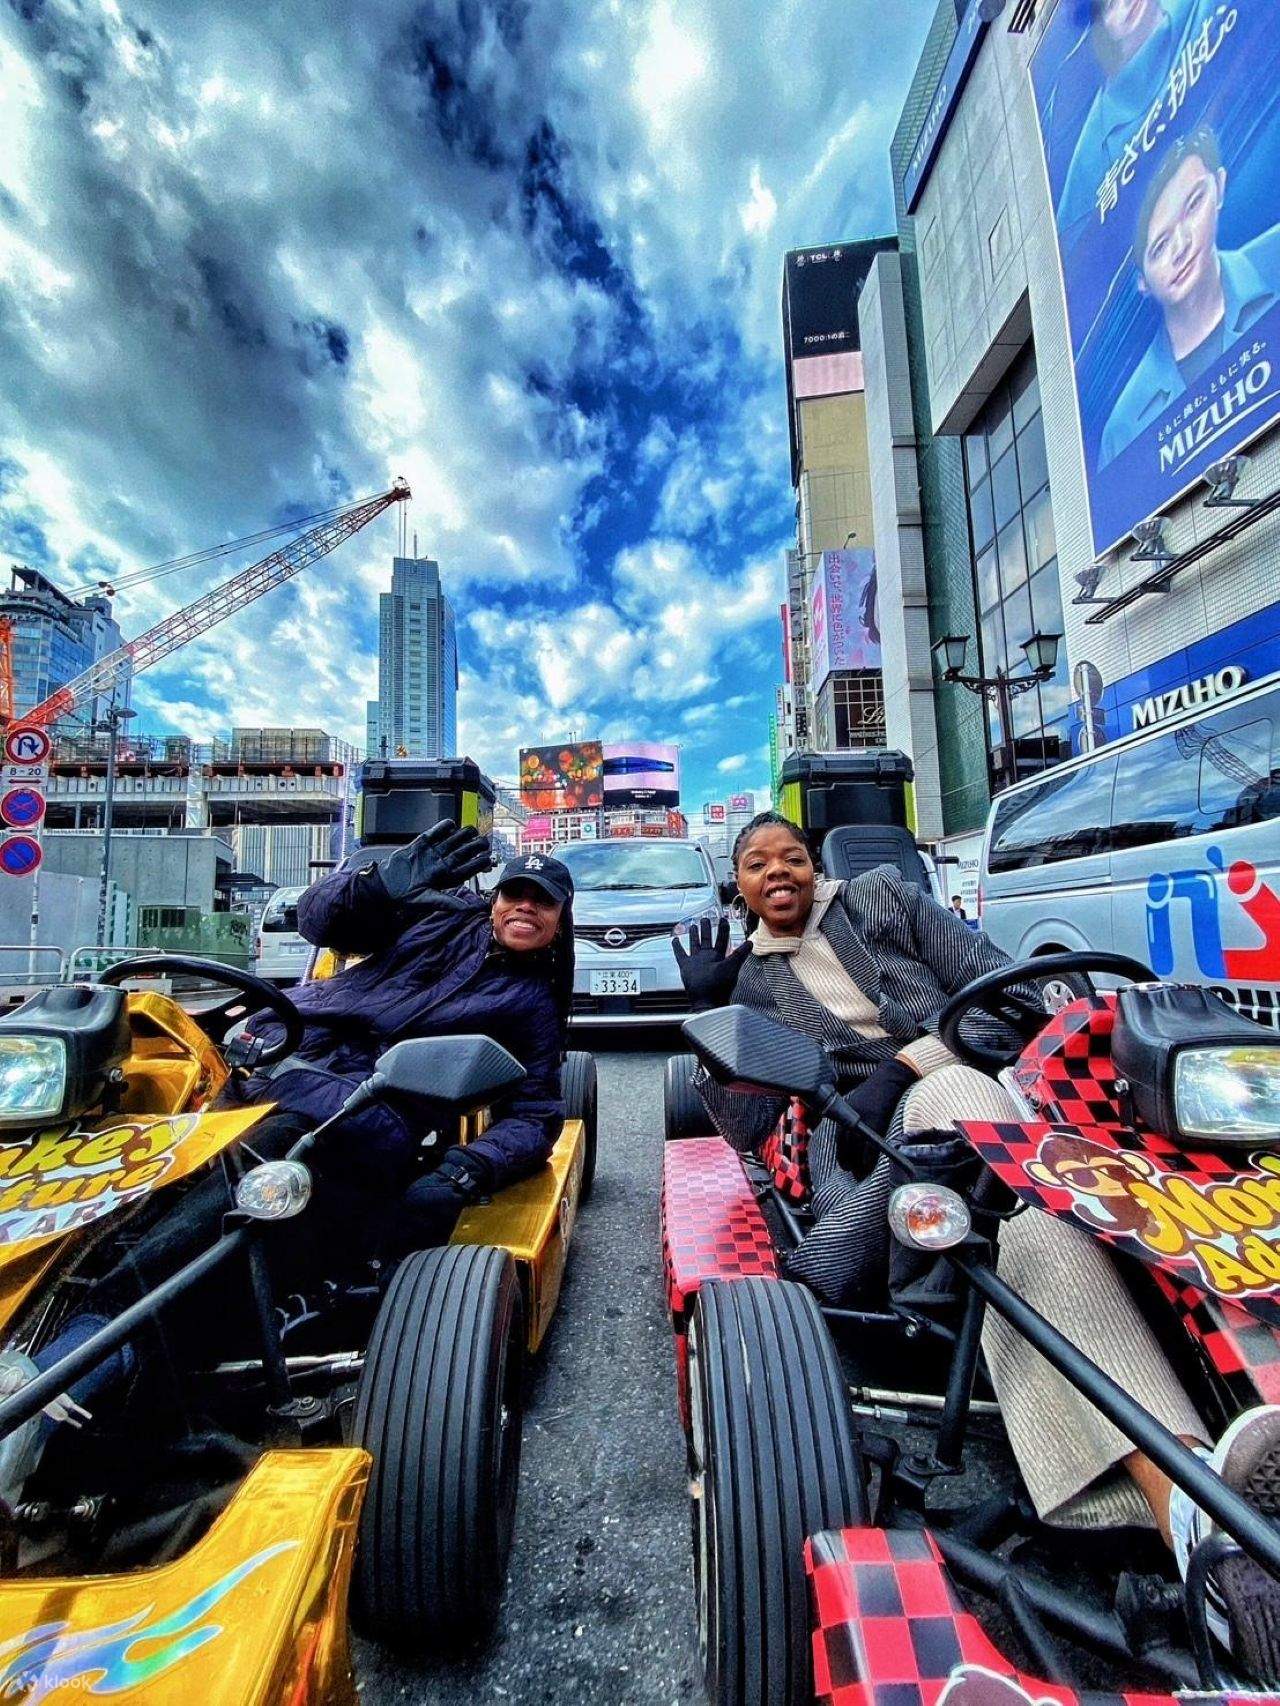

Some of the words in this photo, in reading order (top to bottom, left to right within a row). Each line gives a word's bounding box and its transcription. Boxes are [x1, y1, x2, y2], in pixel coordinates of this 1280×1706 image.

[1159, 360, 1271, 474] MIZUHO
[1131, 665, 1247, 732] MIZUHO
[525, 857, 543, 870] LA
